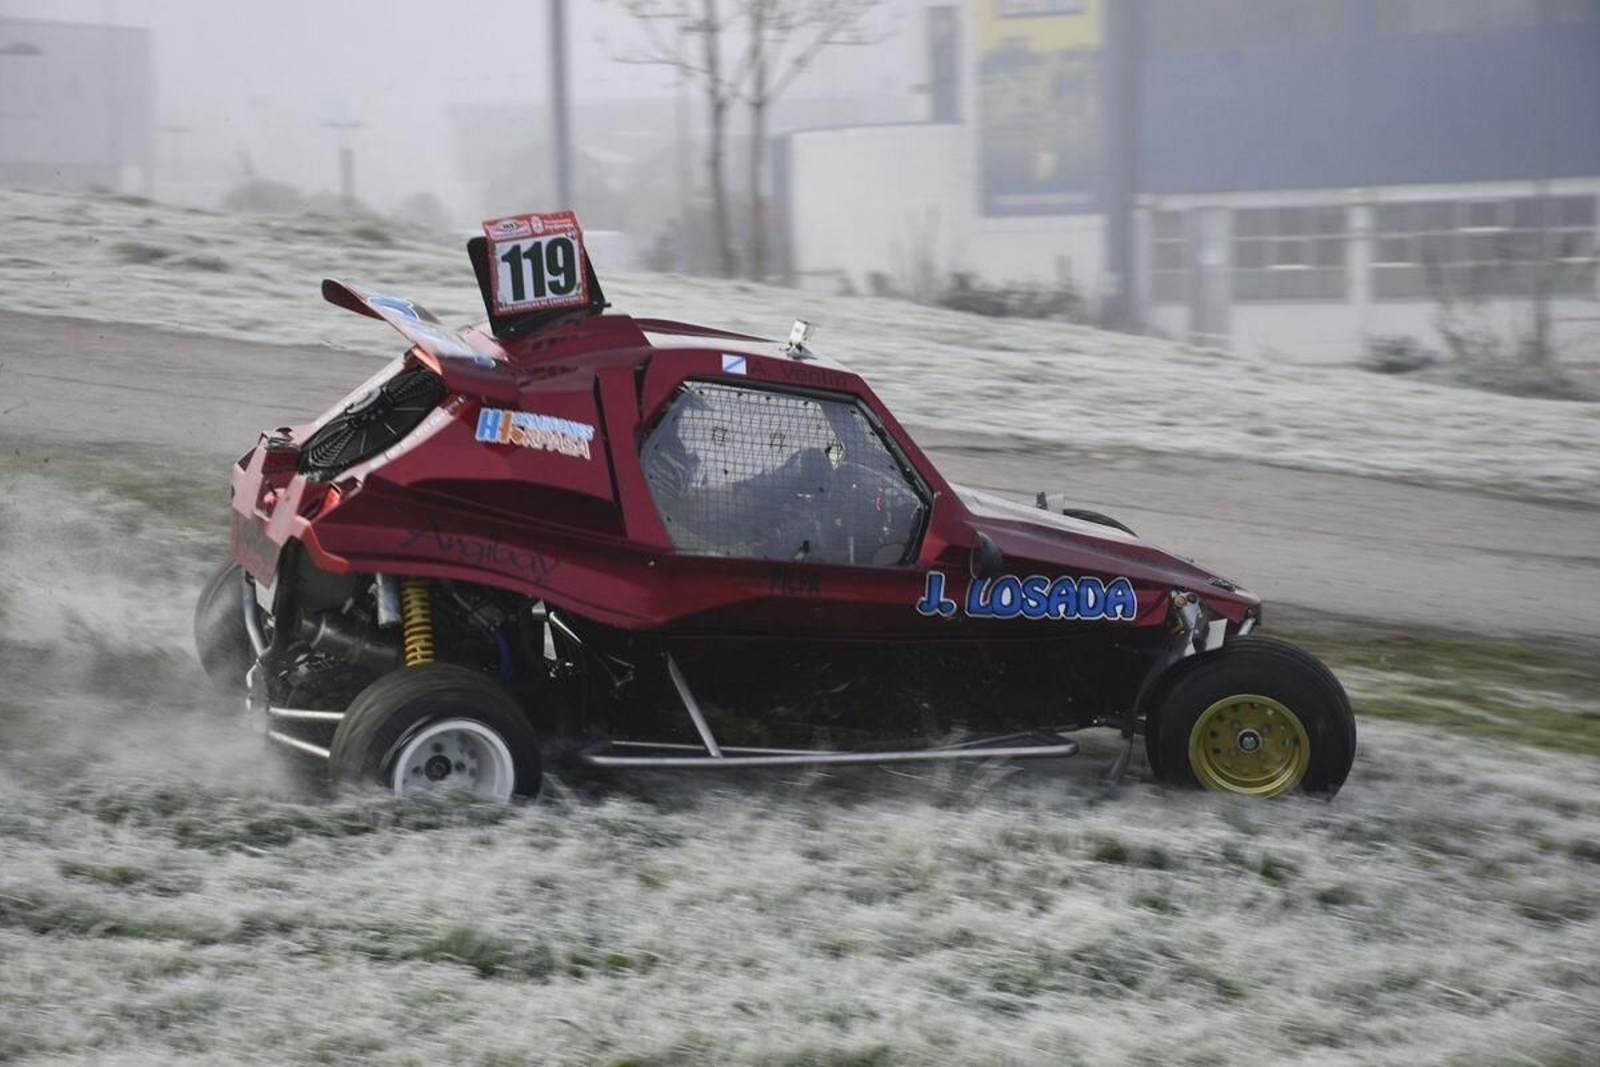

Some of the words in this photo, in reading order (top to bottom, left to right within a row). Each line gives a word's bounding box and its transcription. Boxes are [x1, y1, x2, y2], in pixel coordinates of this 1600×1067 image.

[500, 237, 577, 302] 119
[916, 571, 957, 617] J.
[965, 575, 1138, 621] LOSADA
